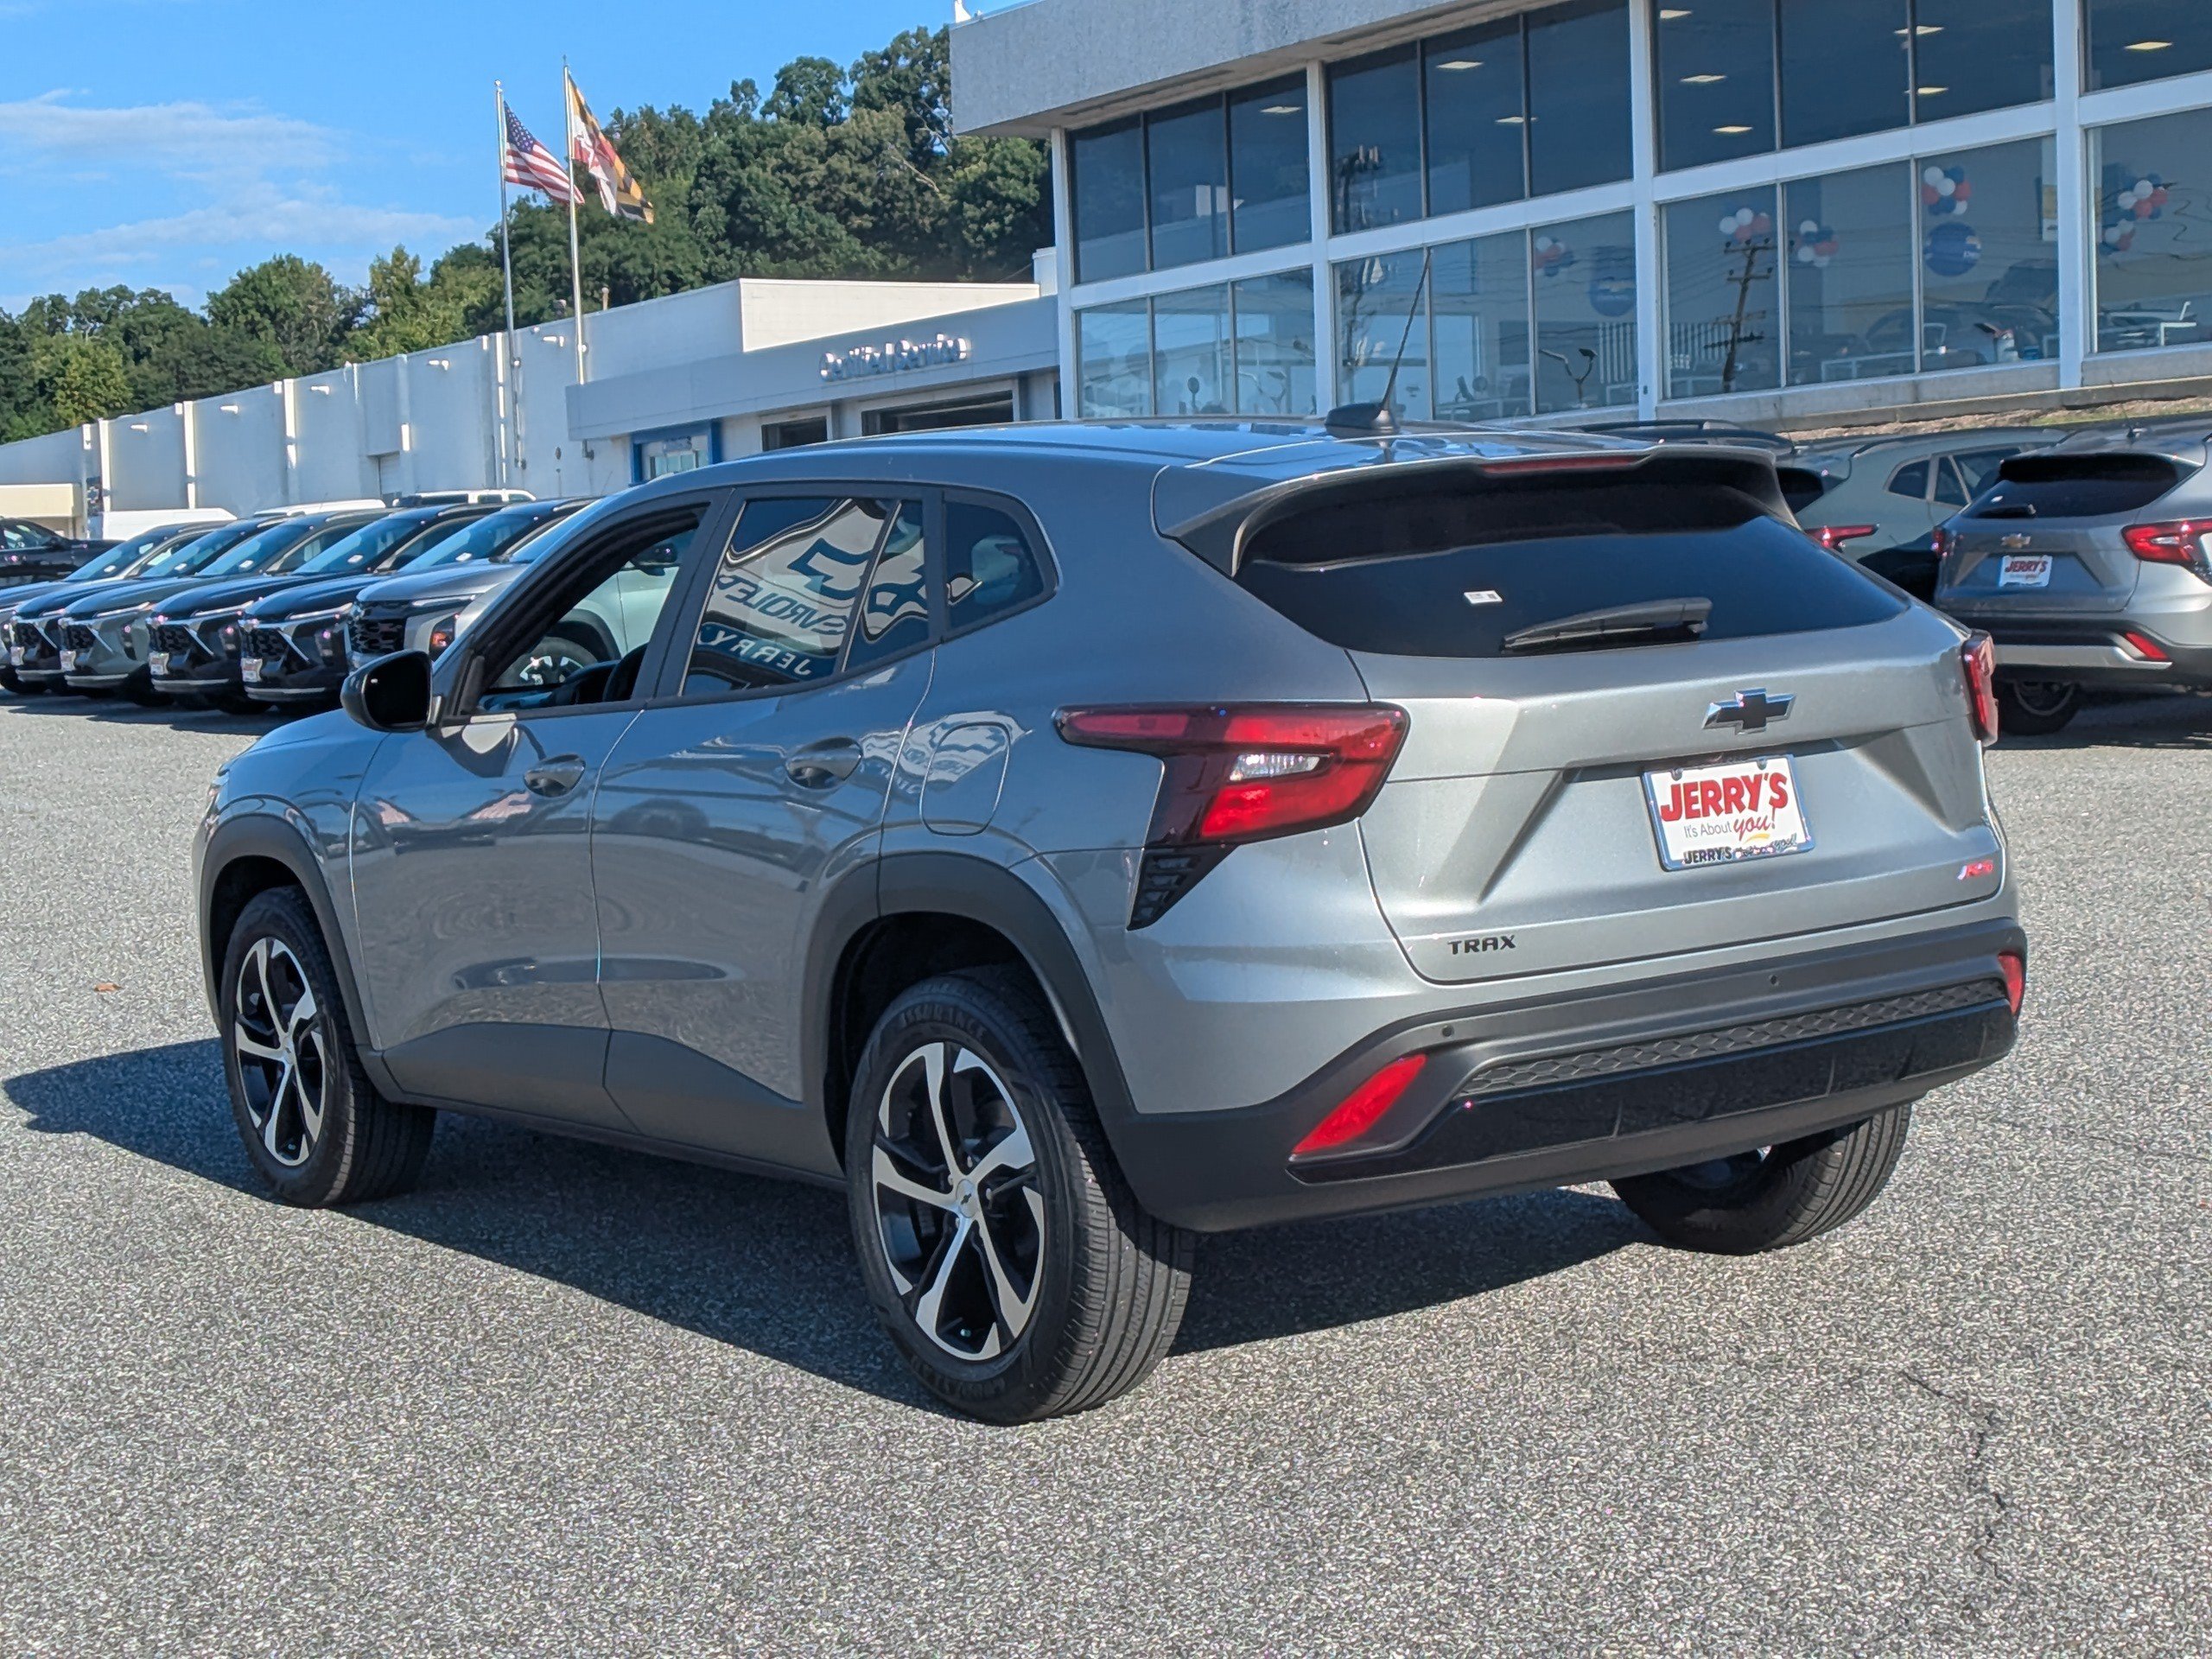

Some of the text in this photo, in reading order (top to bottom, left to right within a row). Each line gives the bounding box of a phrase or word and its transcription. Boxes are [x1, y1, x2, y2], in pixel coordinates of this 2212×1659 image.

[1660, 772, 1789, 823] JERRY'S
[1684, 806, 1777, 842] It's About you!
[1683, 846, 1732, 864] JERRY'S
[1447, 934, 1516, 955] TRAX
